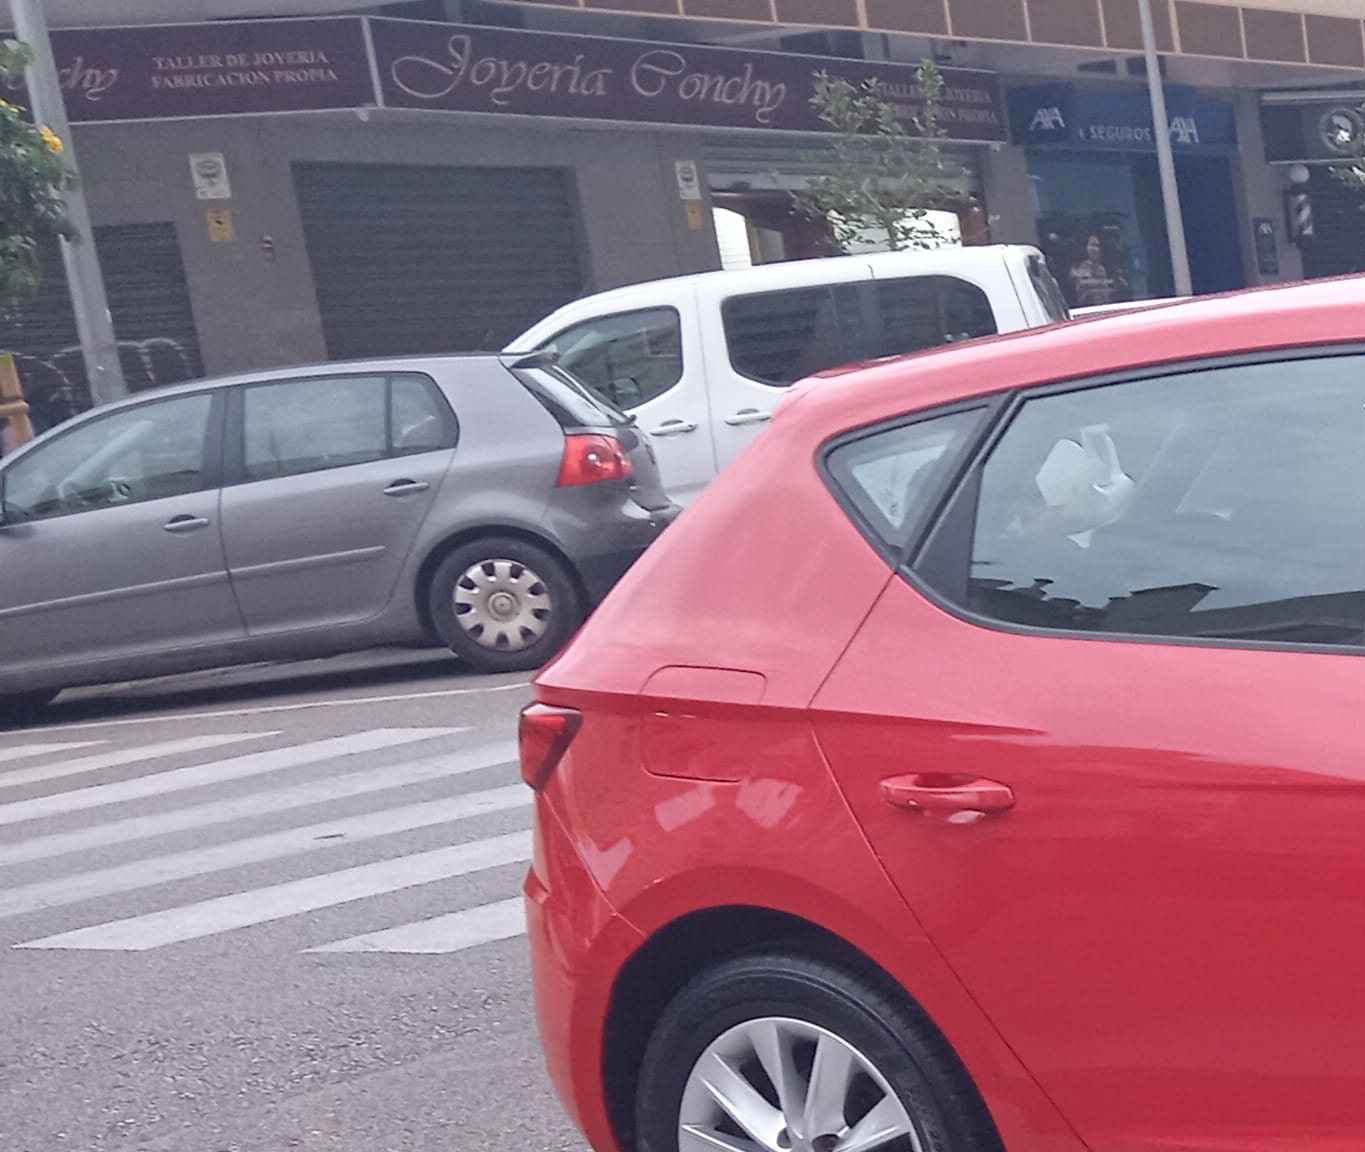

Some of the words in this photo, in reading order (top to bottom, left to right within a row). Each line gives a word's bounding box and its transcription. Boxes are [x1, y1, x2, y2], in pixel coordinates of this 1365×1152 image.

[152, 55, 224, 70] TALLER
[226, 54, 249, 68] DE
[273, 68, 338, 83] PROPIA
[631, 49, 787, 124] Conchy
[1029, 107, 1065, 131] AXA
[1090, 126, 1151, 142] SEGUROS
[1168, 116, 1200, 144] AXA
